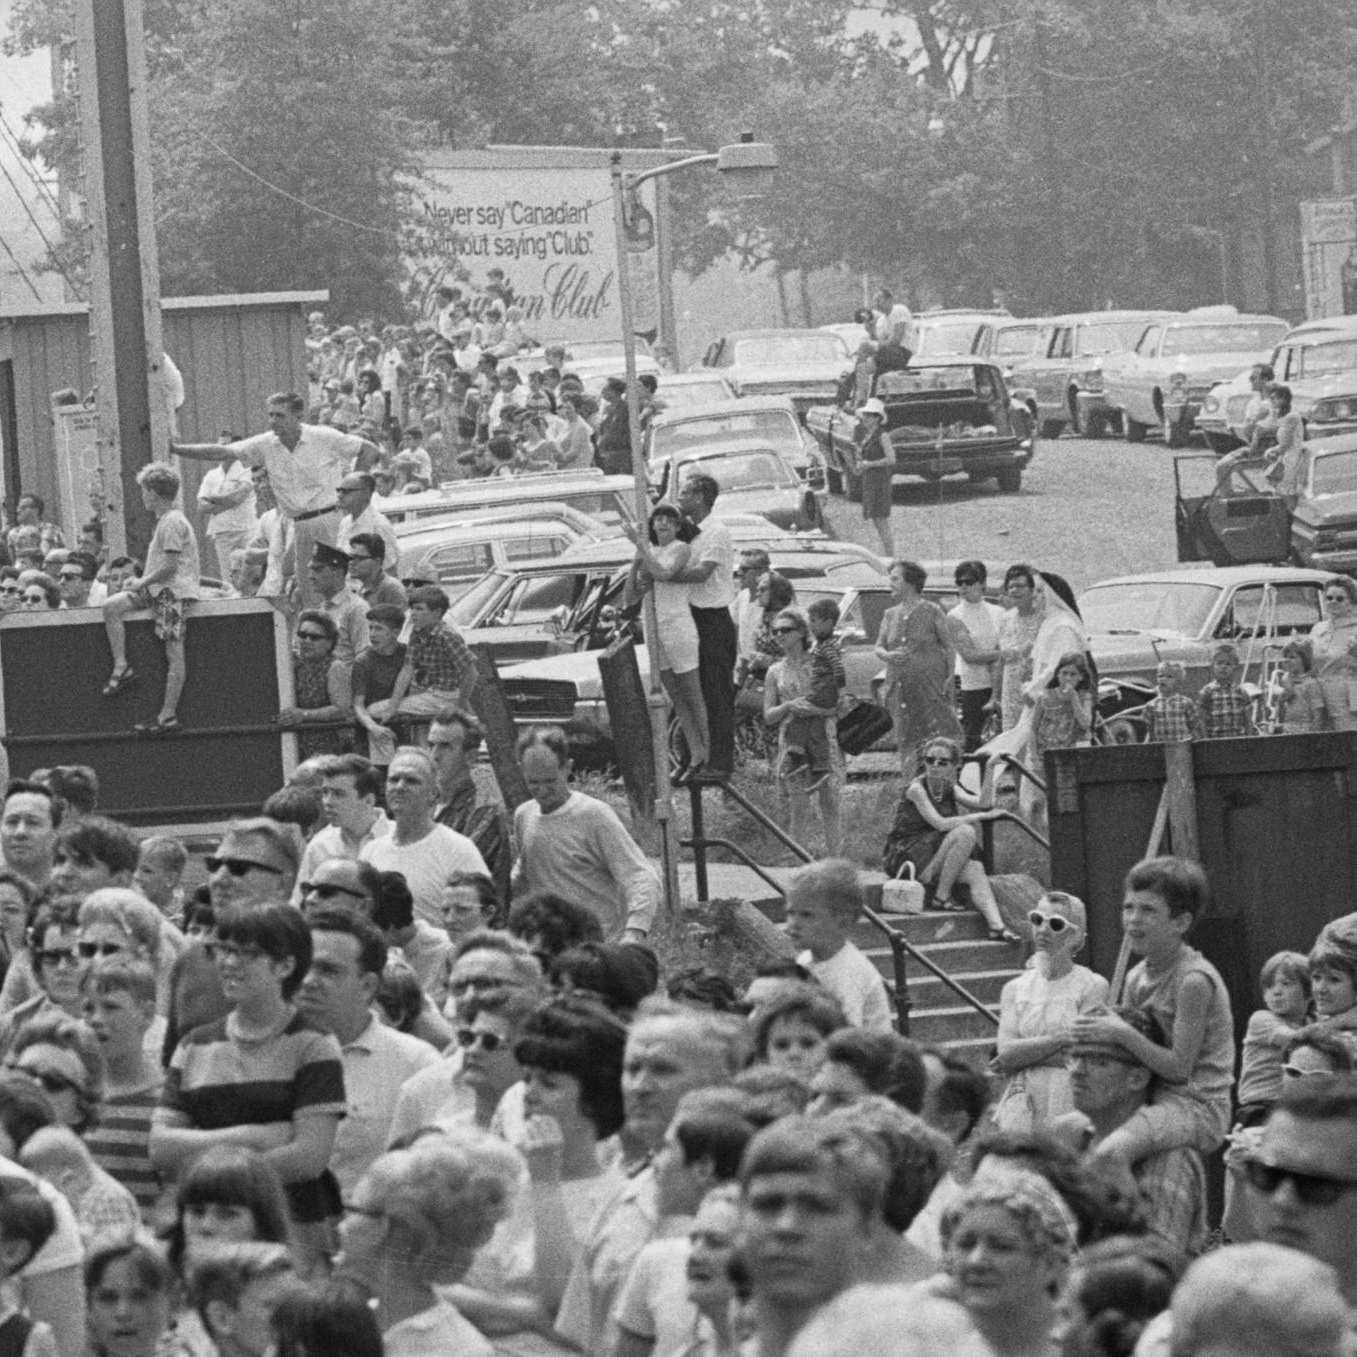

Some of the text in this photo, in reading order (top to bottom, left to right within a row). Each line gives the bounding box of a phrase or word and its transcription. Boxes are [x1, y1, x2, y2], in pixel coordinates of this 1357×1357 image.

[423, 200, 592, 229] Never say "Canadian"
[494, 232, 546, 260] saying
[544, 262, 614, 321] Club
